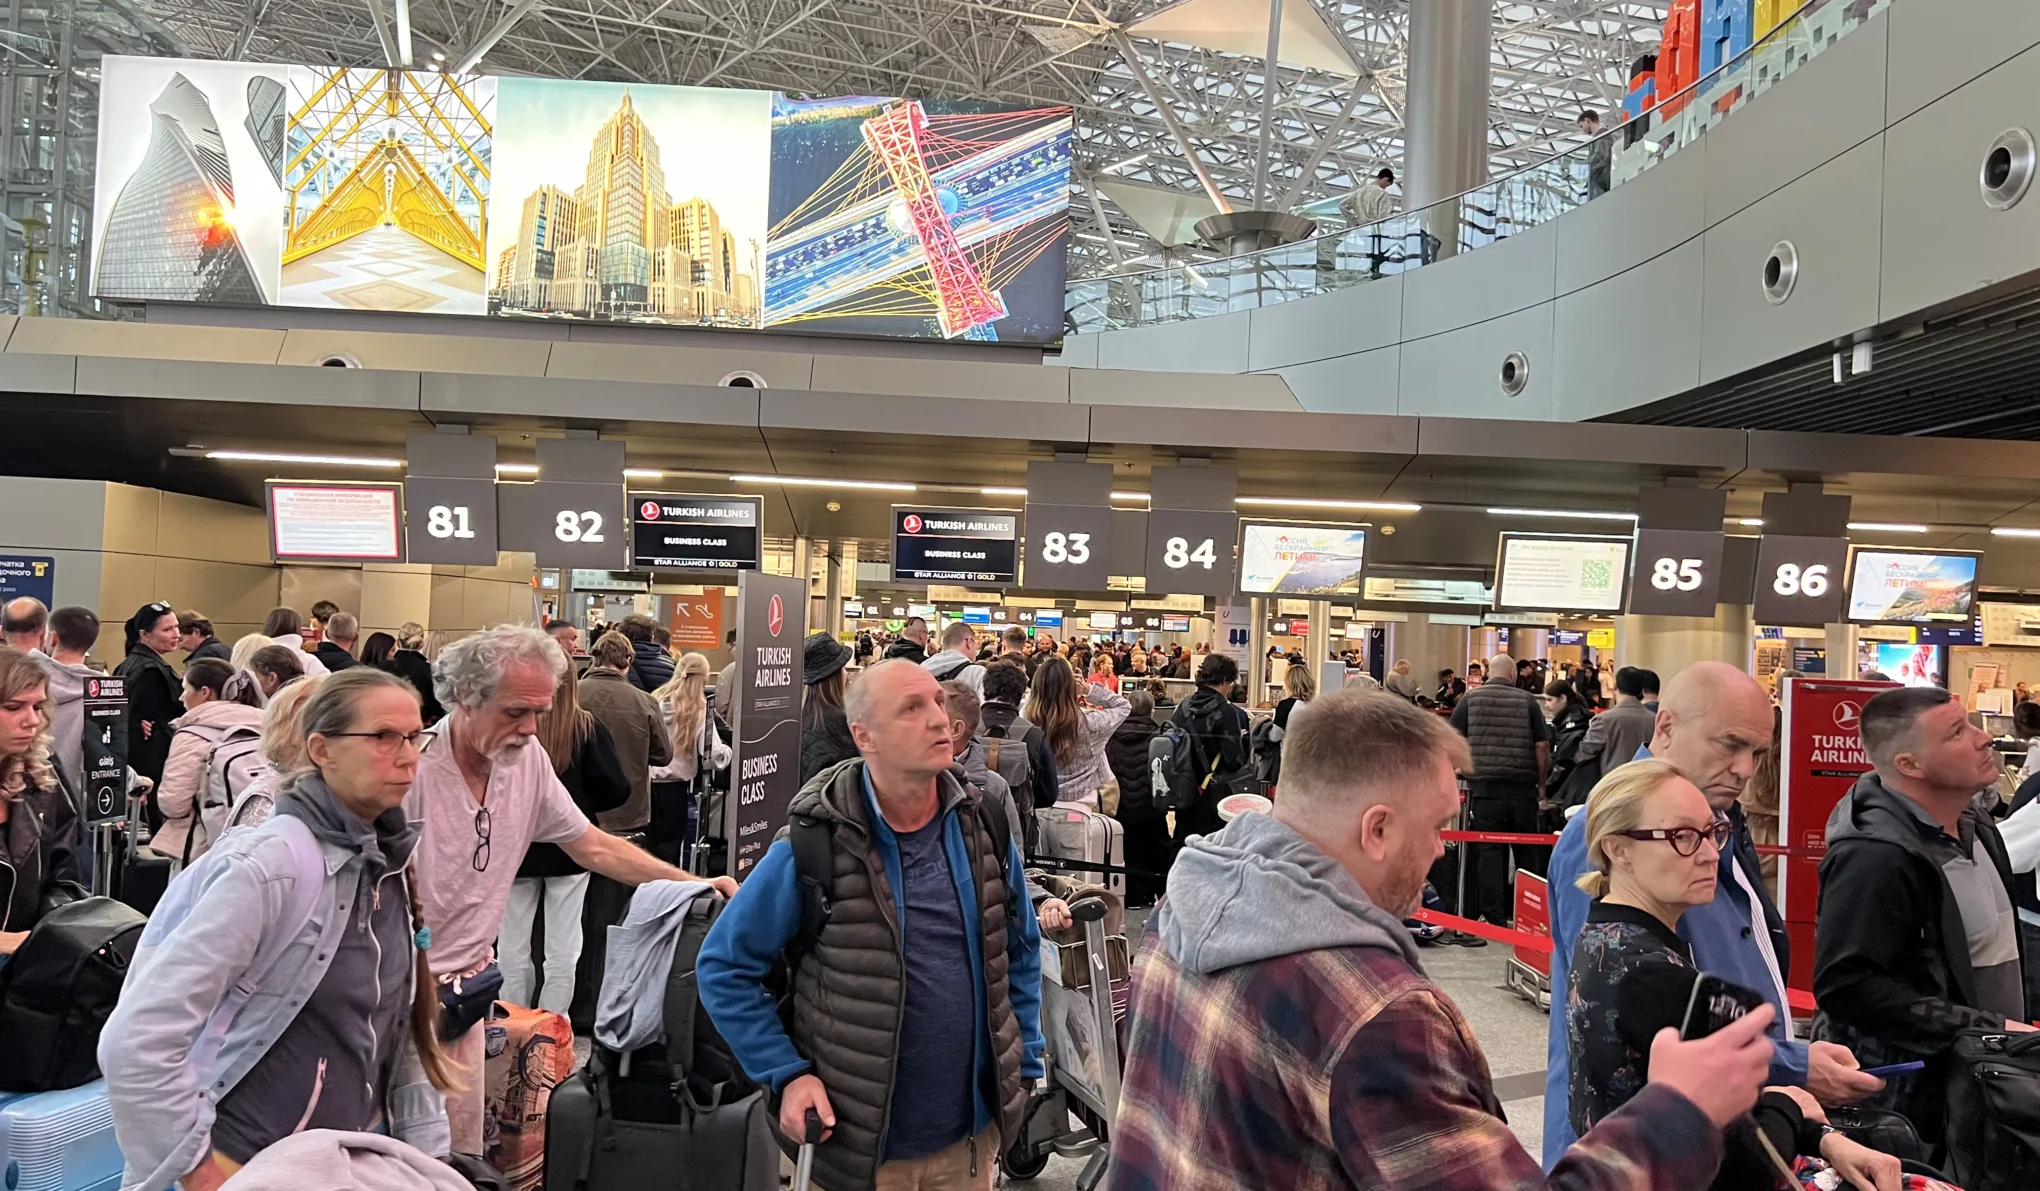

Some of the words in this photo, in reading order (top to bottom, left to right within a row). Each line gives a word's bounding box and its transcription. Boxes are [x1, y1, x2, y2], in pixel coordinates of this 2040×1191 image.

[662, 507, 705, 517] TURKISH
[706, 508, 750, 518] AIRLINES
[427, 505, 475, 539] 81
[555, 510, 604, 543] 82
[924, 520, 966, 530] TURKISH
[967, 522, 1009, 532] AIRLINES
[664, 537, 702, 546] BUSINESS
[702, 538, 727, 546] CLASS
[1042, 531, 1091, 565] 83
[924, 550, 962, 559] BUSINESS
[1163, 537, 1218, 570] 84
[932, 572, 966, 580] ALLIANCE
[1651, 557, 1703, 592] 85
[1773, 563, 1828, 597] 86
[1019, 612, 1032, 621] 64
[757, 647, 792, 666] TURKISH
[100, 680, 124, 688] TURKISH
[755, 667, 791, 688] AIRLINES
[100, 688, 124, 696] AIRLINES
[1812, 735, 1864, 749] TURKI
[91, 769, 121, 780] ENTRANCE
[742, 753, 778, 780] BUSINESS
[741, 780, 765, 806] CLASS
[740, 820, 768, 837] Miles&Smiles
